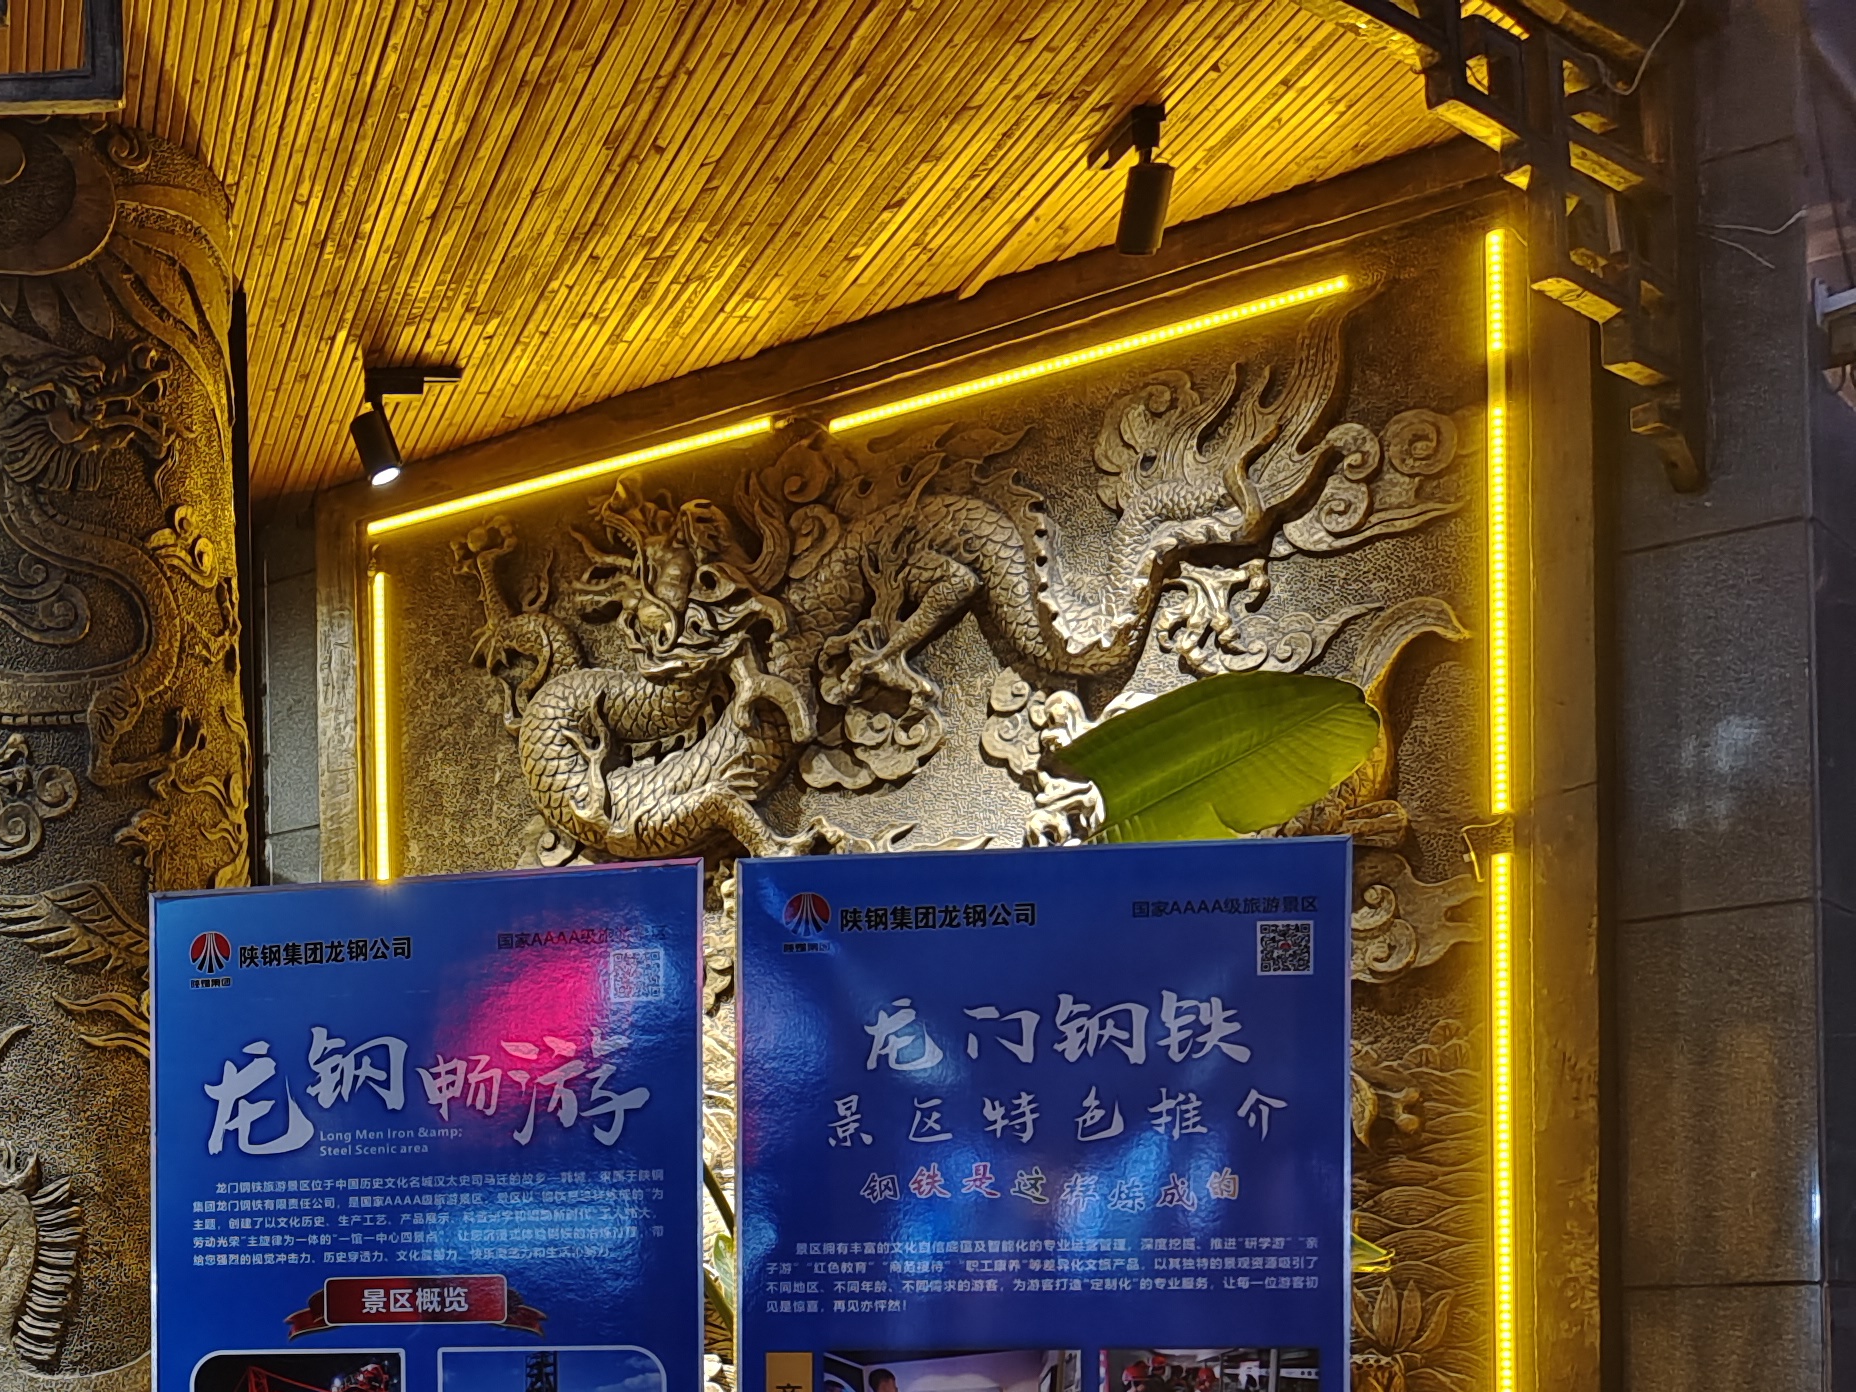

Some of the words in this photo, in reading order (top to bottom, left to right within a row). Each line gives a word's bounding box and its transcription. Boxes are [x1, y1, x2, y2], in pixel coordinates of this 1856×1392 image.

[840, 902, 1037, 932] 陕钢集团龙钢公司
[1132, 896, 1319, 918] 国家AAAA级旅游景区
[497, 924, 667, 949] 国家AAAA级旅区
[239, 936, 412, 968] 陕钢集团龙钢公司
[864, 988, 1252, 1071] 龙门钢铁
[204, 1026, 650, 1155] 龙钢畅游
[826, 1084, 1289, 1148] 景区特色推介
[319, 1130, 352, 1143] Long
[355, 1129, 384, 1140] Men
[387, 1127, 414, 1139] Iron
[319, 1144, 352, 1157] Steel
[355, 1143, 397, 1155] Scenic
[400, 1143, 429, 1154] area
[860, 1161, 1240, 1212] 钢铁是这样炼成的
[361, 1286, 469, 1314] 景区概览
